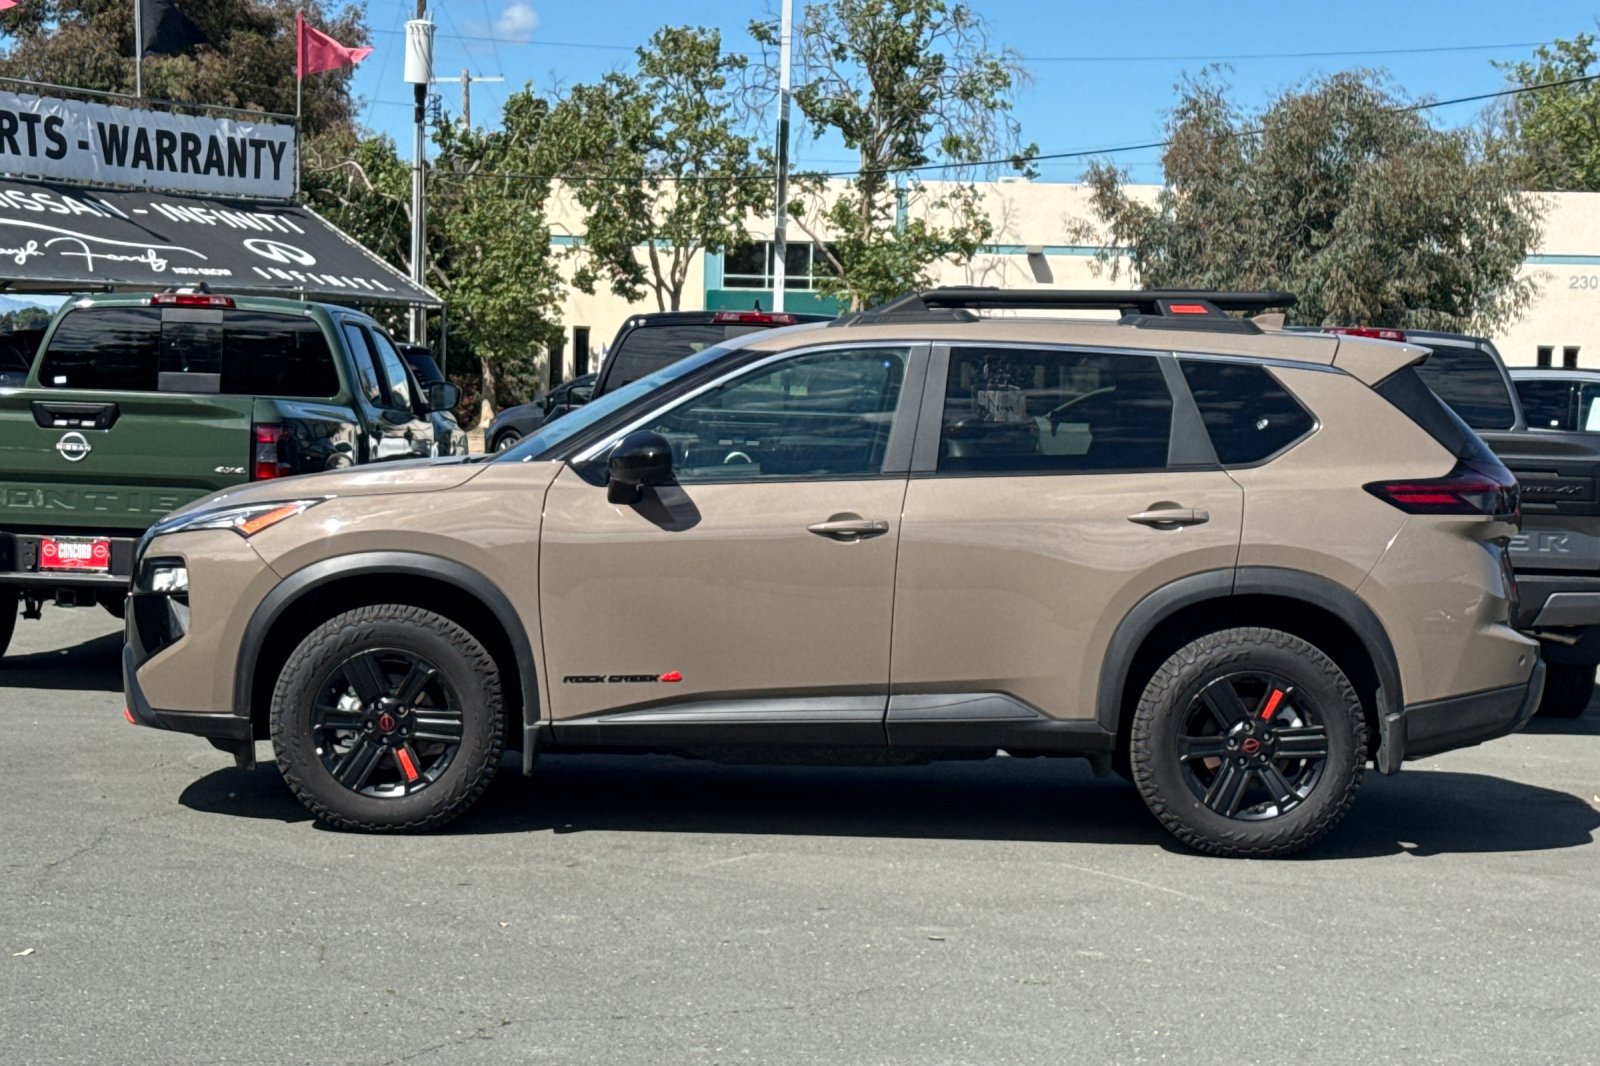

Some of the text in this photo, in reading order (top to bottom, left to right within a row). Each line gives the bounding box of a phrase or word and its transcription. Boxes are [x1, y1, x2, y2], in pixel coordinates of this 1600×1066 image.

[77, 140, 90, 151] -
[97, 121, 287, 180] WARRANTY
[0, 189, 130, 219] ISSAN
[150, 202, 306, 235] INFINITI
[252, 266, 390, 292] INFINITI
[1568, 274, 1600, 290] 230
[56, 442, 92, 451] NISSAN
[57, 543, 92, 559] CONCORD
[562, 674, 660, 684] ROCK CREEK
